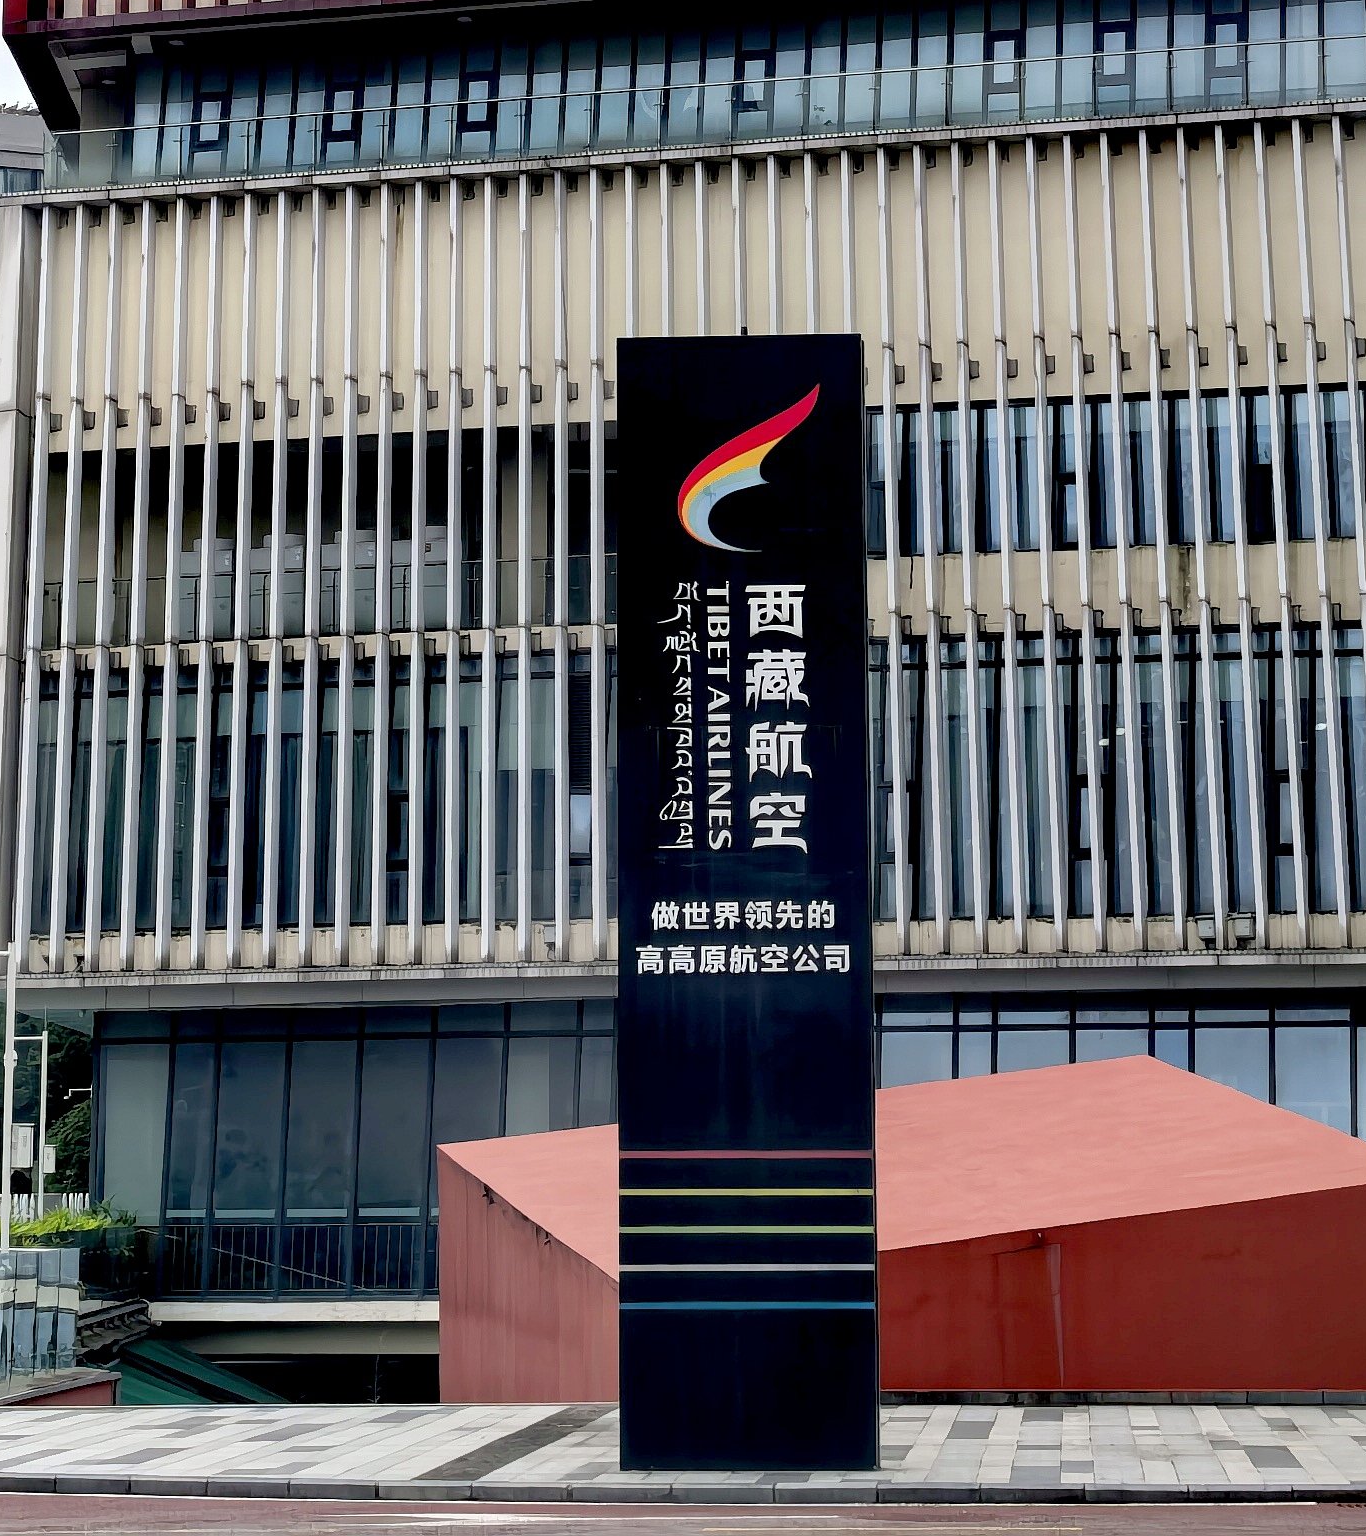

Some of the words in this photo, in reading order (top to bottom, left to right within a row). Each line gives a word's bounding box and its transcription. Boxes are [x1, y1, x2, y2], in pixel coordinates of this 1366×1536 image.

[706, 580, 731, 683] TIBET
[707, 686, 733, 851] AIRLINES
[745, 584, 813, 854] 西藏航空
[636, 944, 851, 975] 高高原航空公司
[651, 900, 835, 931] 做世界领先的
